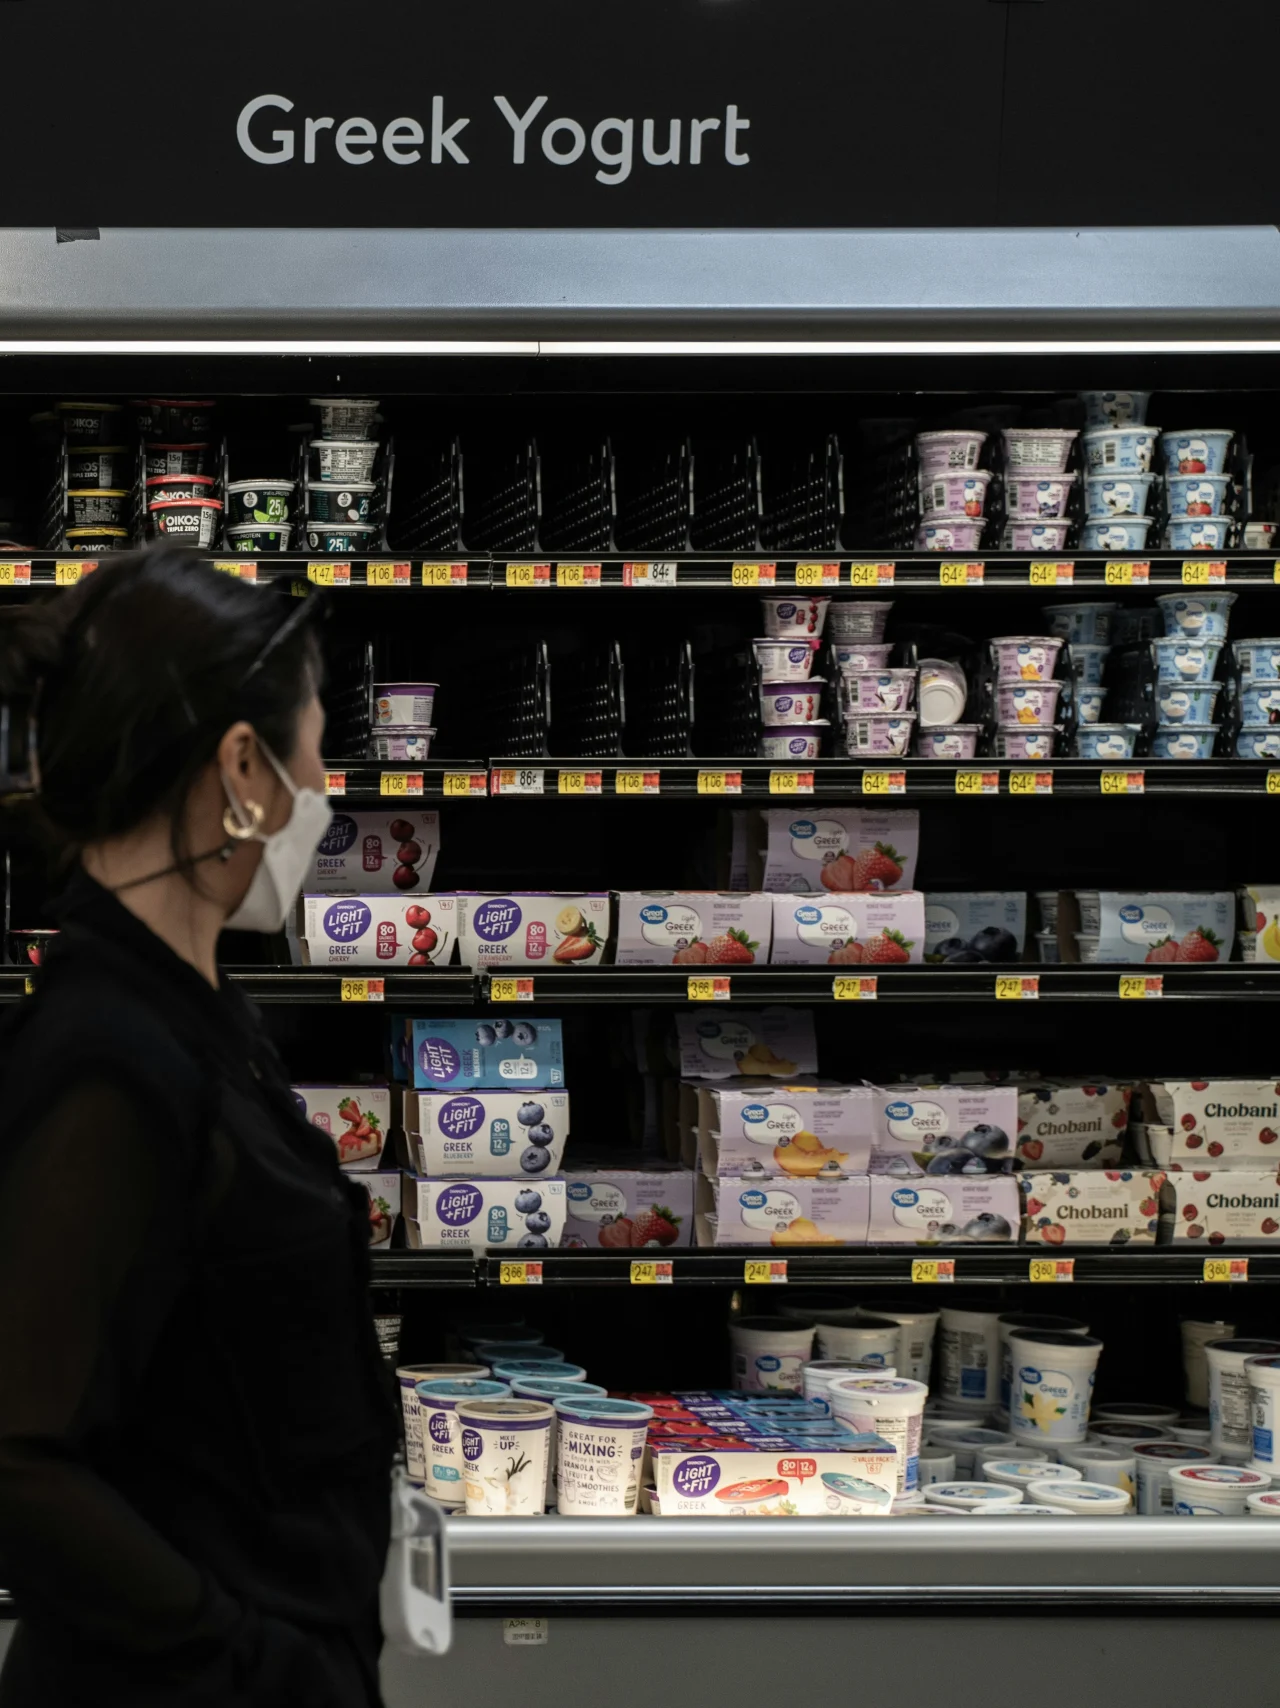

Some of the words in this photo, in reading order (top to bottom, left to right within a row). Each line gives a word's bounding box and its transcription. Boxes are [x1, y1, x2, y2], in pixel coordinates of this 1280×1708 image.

[236, 94, 470, 164] Greek
[494, 95, 750, 185] Yogurt
[166, 515, 199, 526] OIKOS
[318, 858, 345, 868] GREEK
[329, 945, 358, 955] GREEK
[478, 944, 507, 954] GREEK
[1204, 1103, 1277, 1117] Chobani
[1037, 1117, 1102, 1135] Chobani
[444, 1142, 473, 1152] GREEK
[1206, 1193, 1280, 1208] Chobani
[1057, 1203, 1129, 1220] Chobani
[569, 1433, 591, 1443] GREAT
[594, 1435, 616, 1444] FOR
[499, 1441, 514, 1451] UP
[569, 1444, 616, 1457] MIXING
[564, 1461, 594, 1472] GRANOLA
[782, 1460, 796, 1471] 80
[577, 1481, 619, 1492] SMOOTHIES
